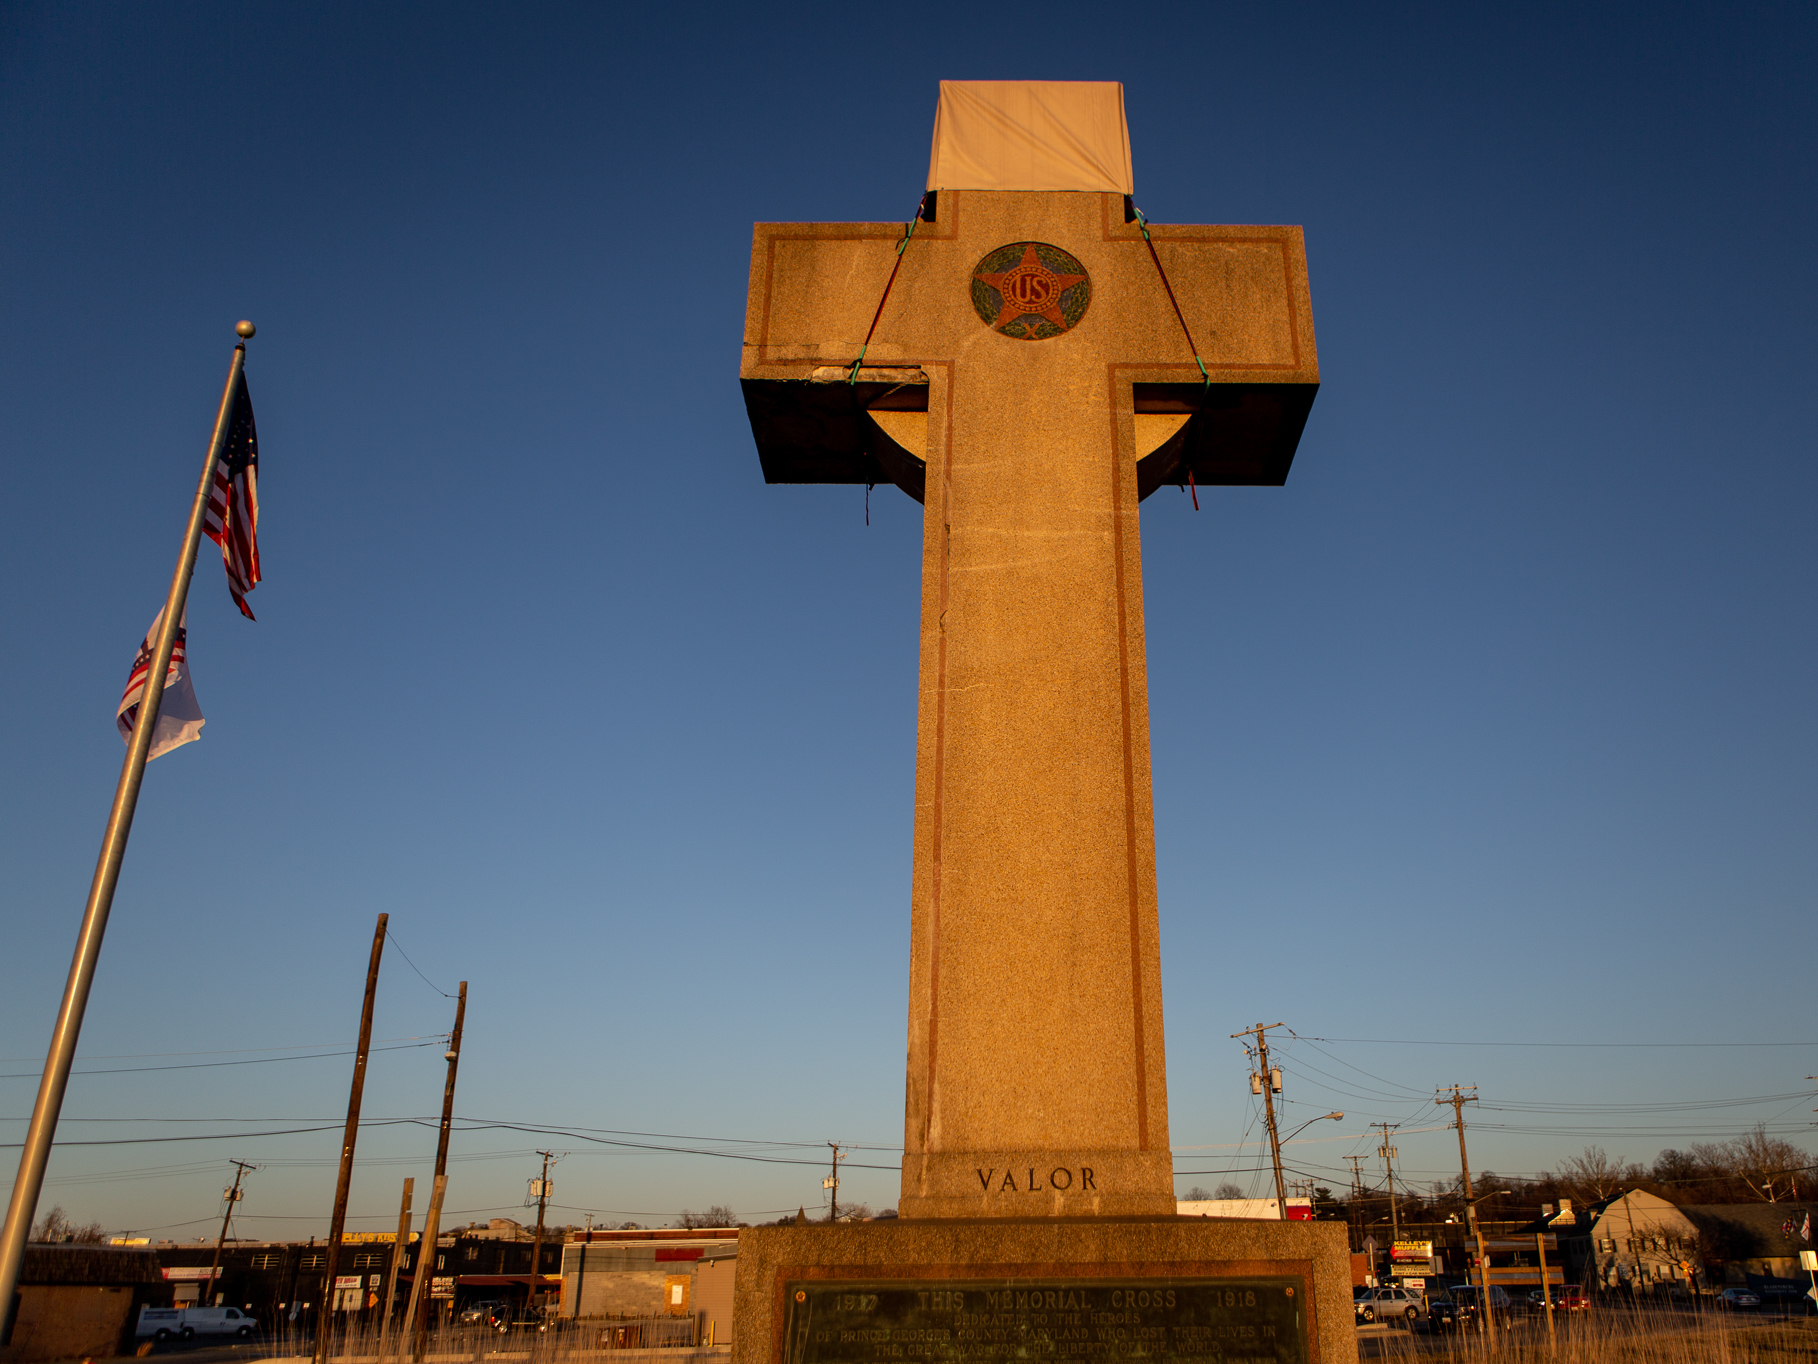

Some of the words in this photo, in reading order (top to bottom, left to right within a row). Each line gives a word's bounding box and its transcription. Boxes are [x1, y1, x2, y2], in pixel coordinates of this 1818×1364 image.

[1014, 275, 1047, 303] US
[976, 1167, 1097, 1192] VALOR
[917, 1291, 964, 1311] THIS
[985, 1290, 1092, 1309] MEMORIAL
[1111, 1290, 1177, 1308] CROSS
[1217, 1290, 1256, 1307] 1918
[953, 1313, 1024, 1325] DEDICATED
[1031, 1313, 1048, 1325] TO
[1055, 1313, 1082, 1325] THE
[1090, 1312, 1141, 1324] HEROES
[815, 1331, 833, 1343] OF
[839, 1330, 888, 1342] PRINCE
[1018, 1328, 1089, 1340] MARYLAND
[1096, 1327, 1126, 1340] WHO
[1133, 1327, 1166, 1339] LOST
[1172, 1326, 1212, 1338] THEIR
[1218, 1326, 1256, 1338] LIVES
[1264, 1325, 1277, 1338] IN
[907, 1344, 947, 1356] GREAT
[955, 1343, 986, 1355] WAR
[992, 1343, 1017, 1355] FOR
[1024, 1343, 1051, 1355] THE
[1058, 1342, 1112, 1354] LIBERTY
[1119, 1341, 1136, 1354] OF
[1143, 1341, 1169, 1353] THE
